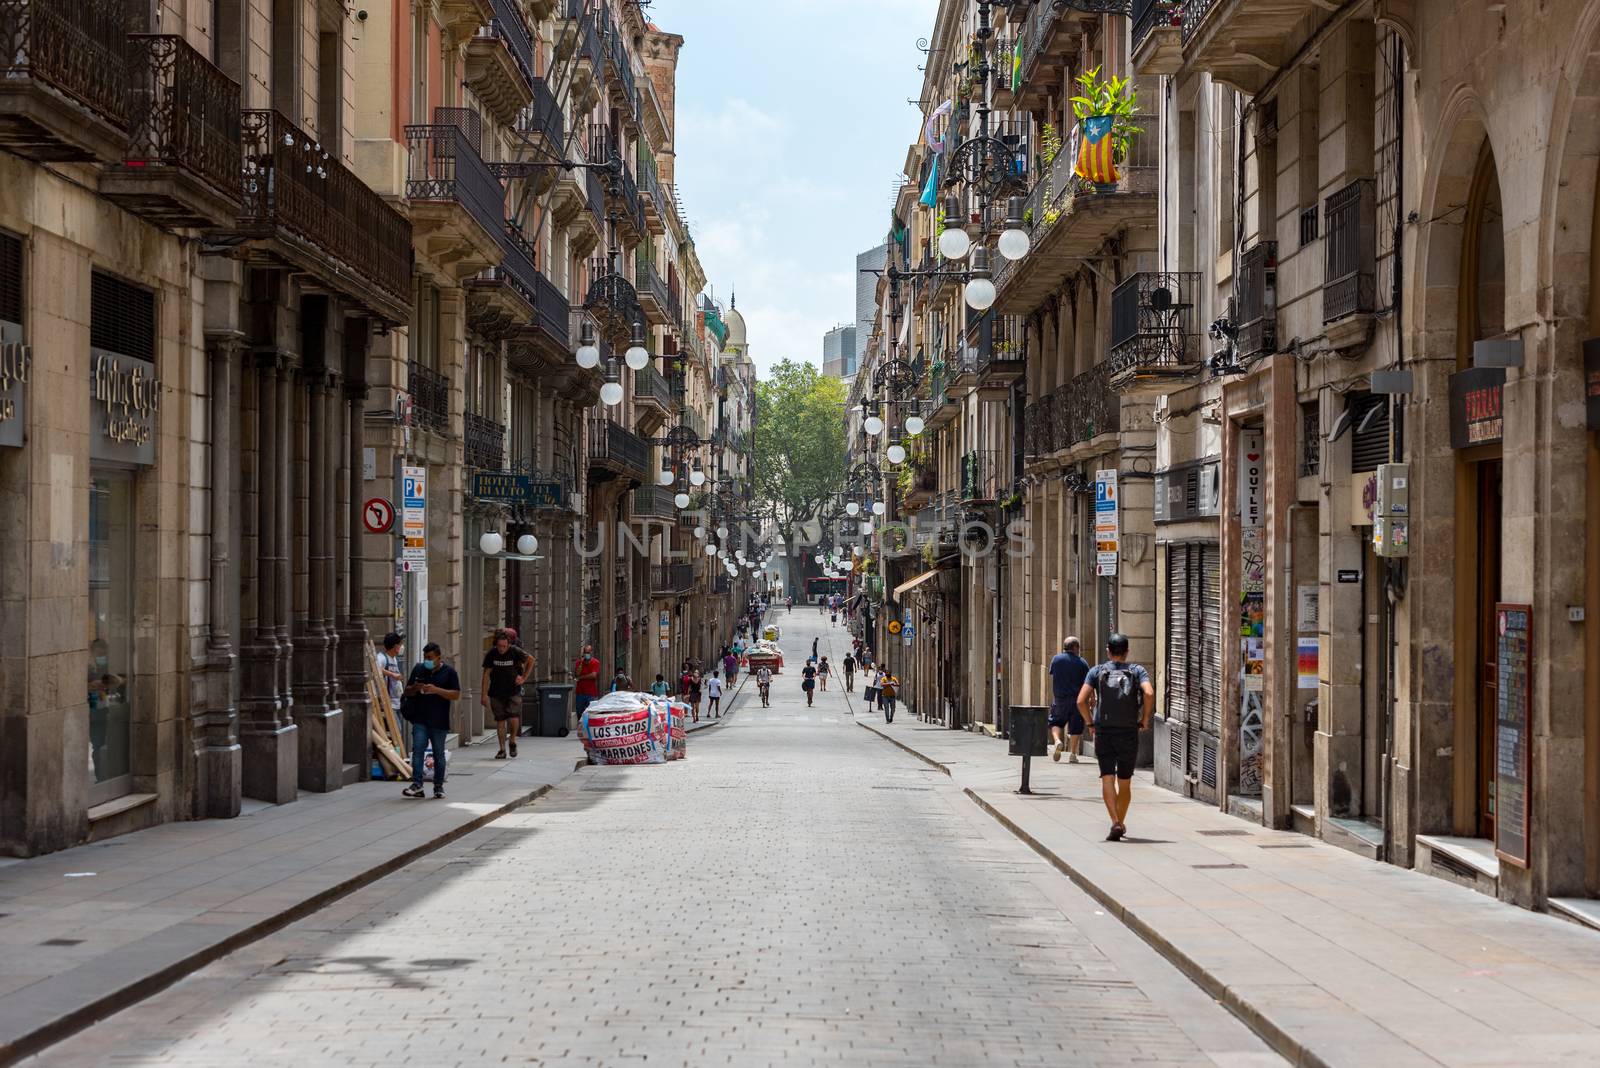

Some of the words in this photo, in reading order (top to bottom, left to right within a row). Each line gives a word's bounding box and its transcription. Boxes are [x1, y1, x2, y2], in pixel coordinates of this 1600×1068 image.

[479, 476, 519, 487] HOTEL
[1249, 467, 1259, 525] OUTLET
[593, 727, 611, 739] LOS
[615, 721, 647, 736] SACOS
[623, 735, 636, 745] CON
[599, 741, 652, 759] MARRONES
